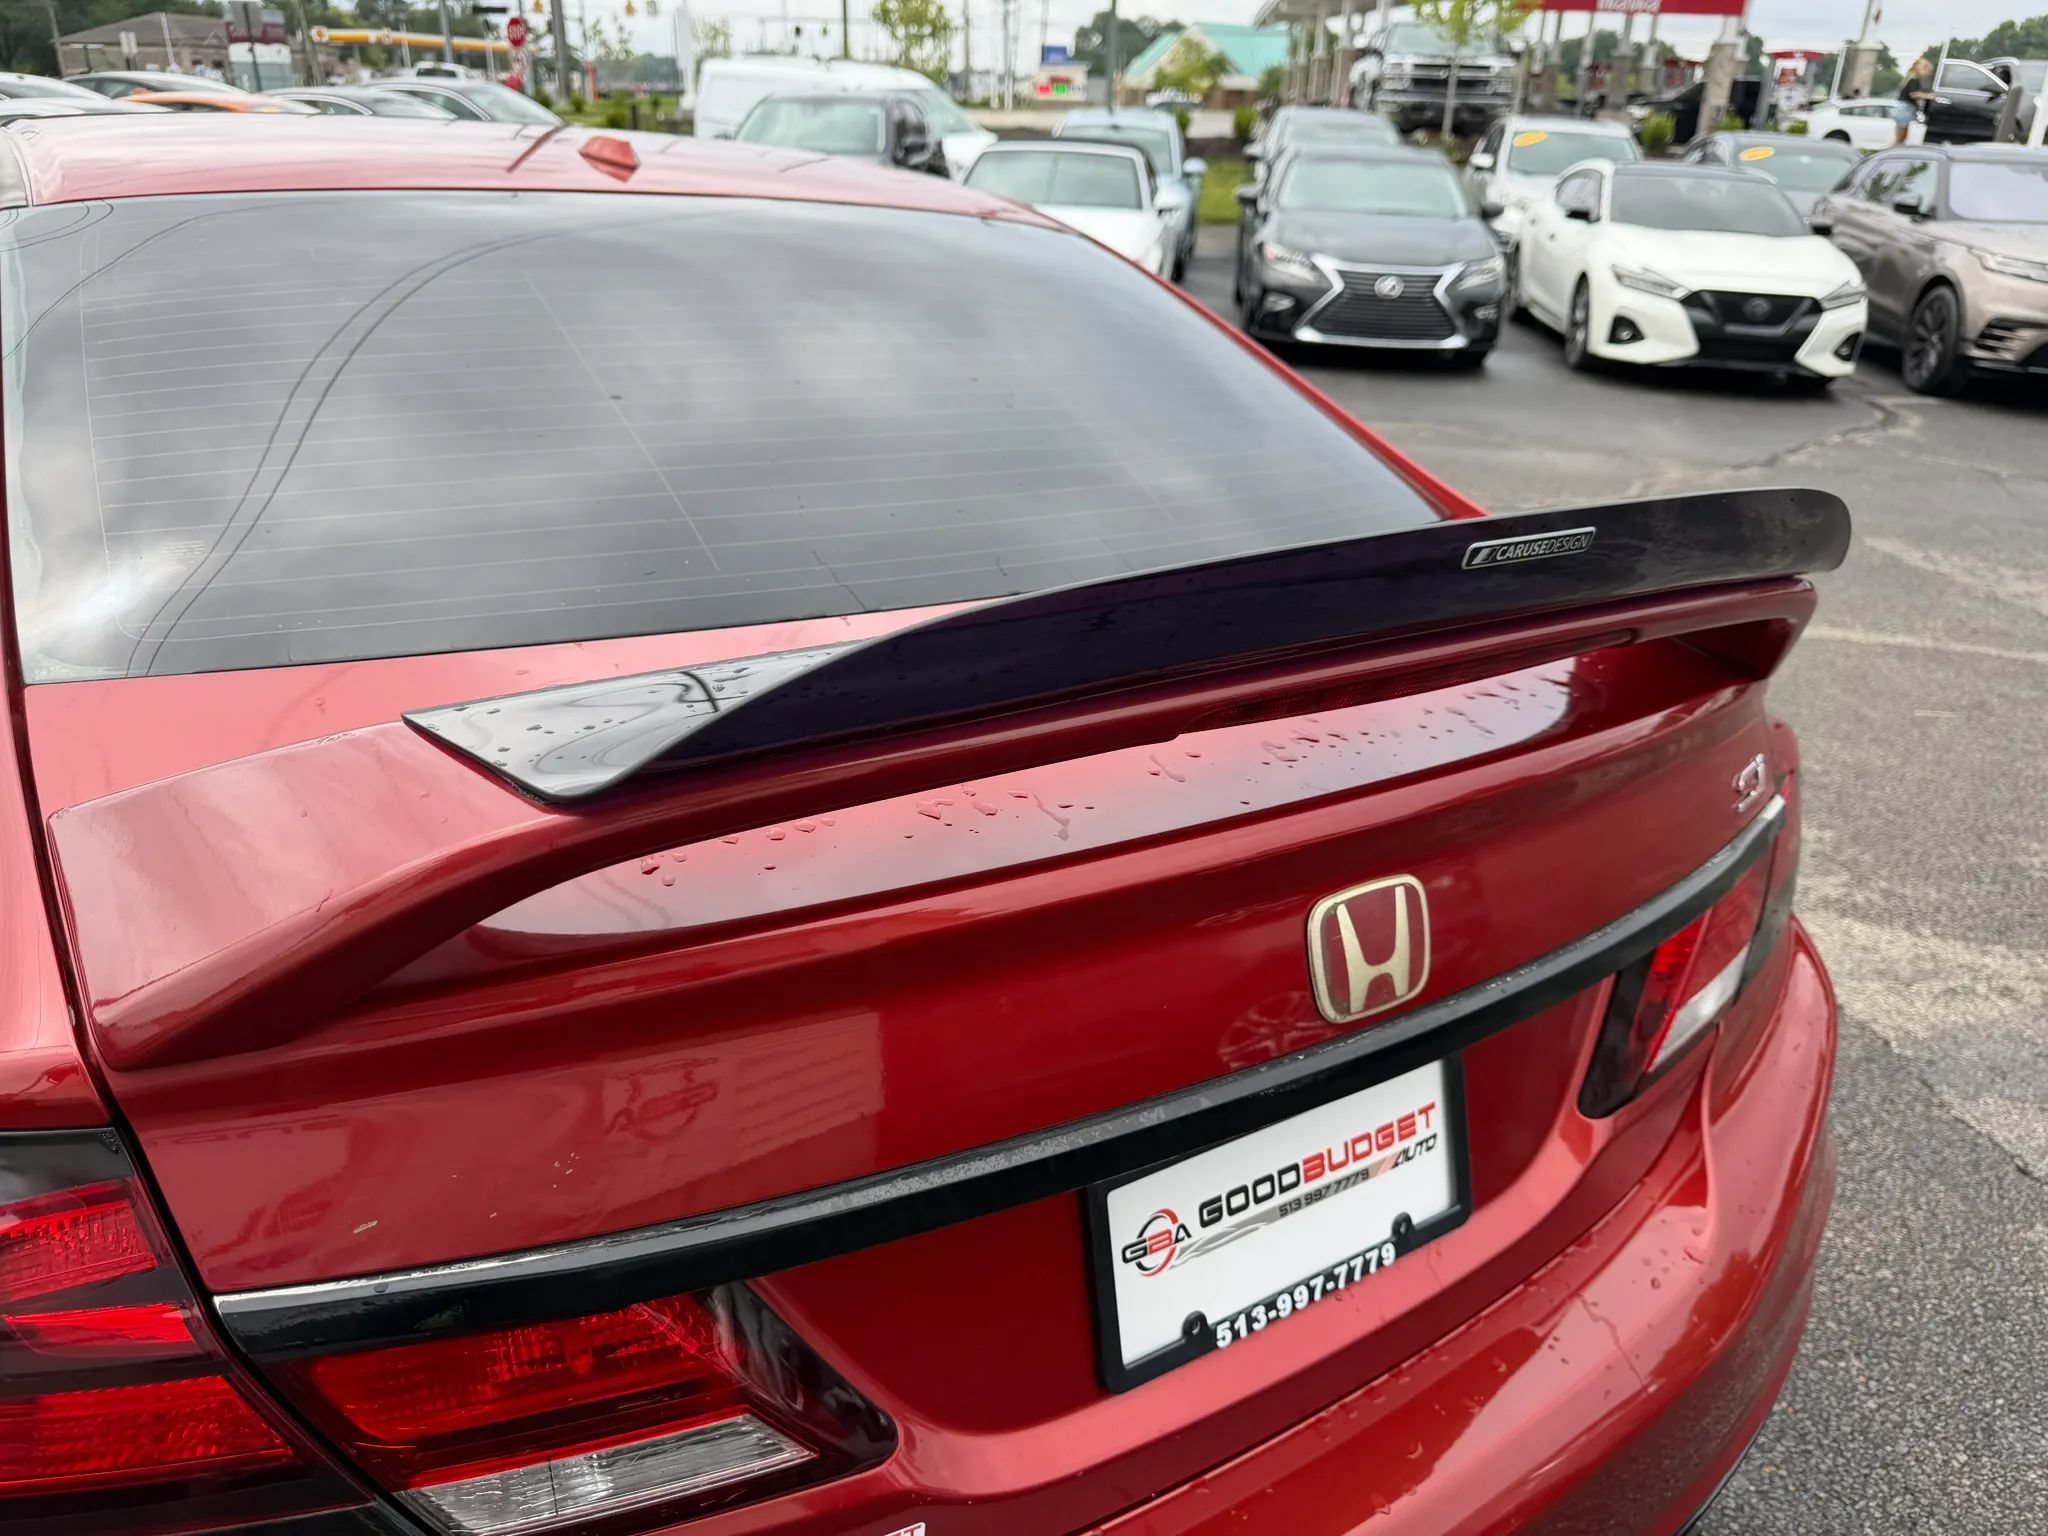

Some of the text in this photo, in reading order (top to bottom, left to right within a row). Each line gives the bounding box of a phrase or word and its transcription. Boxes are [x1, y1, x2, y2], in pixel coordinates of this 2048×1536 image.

[1391, 1132, 1438, 1170] AUTO
[1278, 1167, 1370, 1218] 513 997 7779
[1121, 1222, 1193, 1265] GBA
[1215, 1242, 1397, 1349] 513-997-7779
